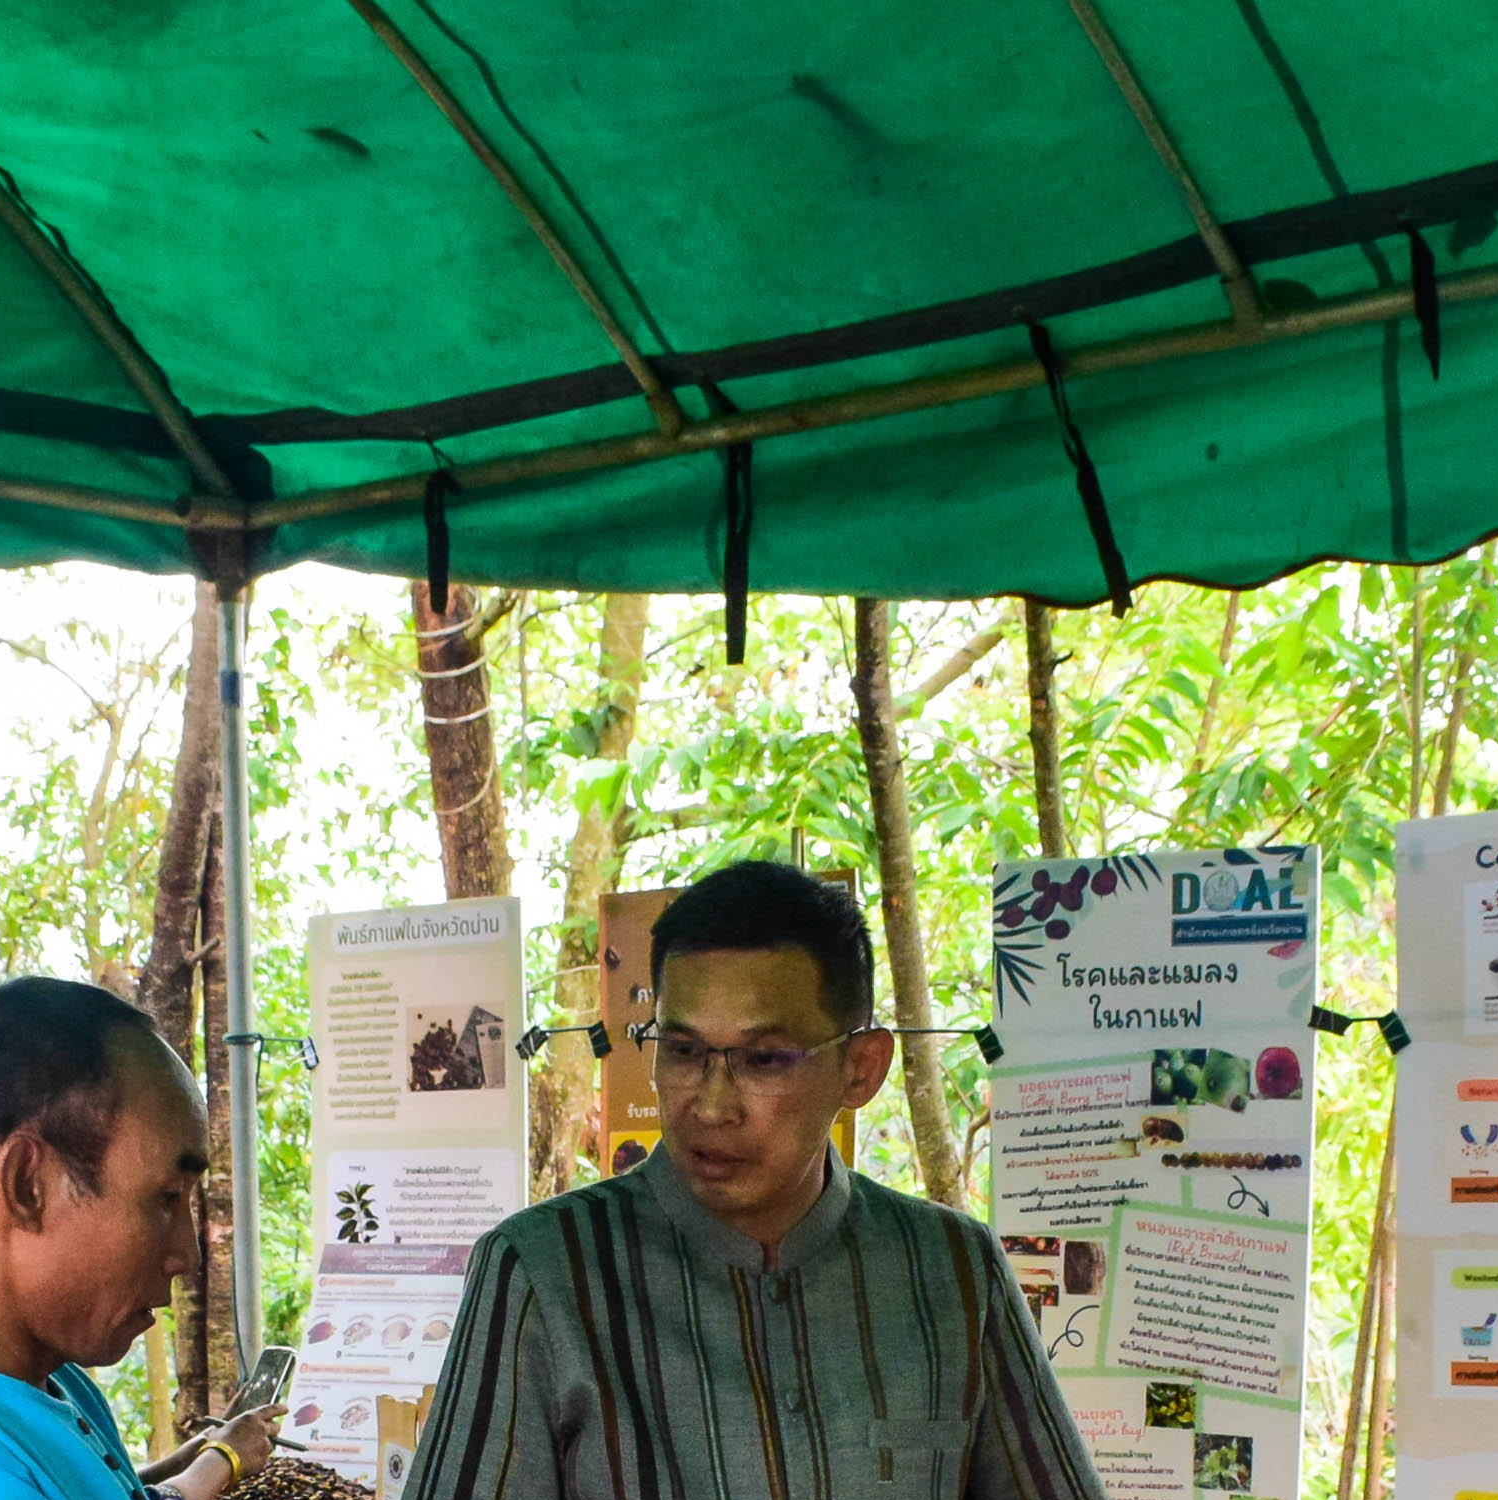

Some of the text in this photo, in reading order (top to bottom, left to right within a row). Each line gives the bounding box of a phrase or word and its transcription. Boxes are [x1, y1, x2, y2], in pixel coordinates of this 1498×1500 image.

[1057, 953, 1238, 987] โรคและแมลง
[1089, 995, 1202, 1029] ในกาแฟ
